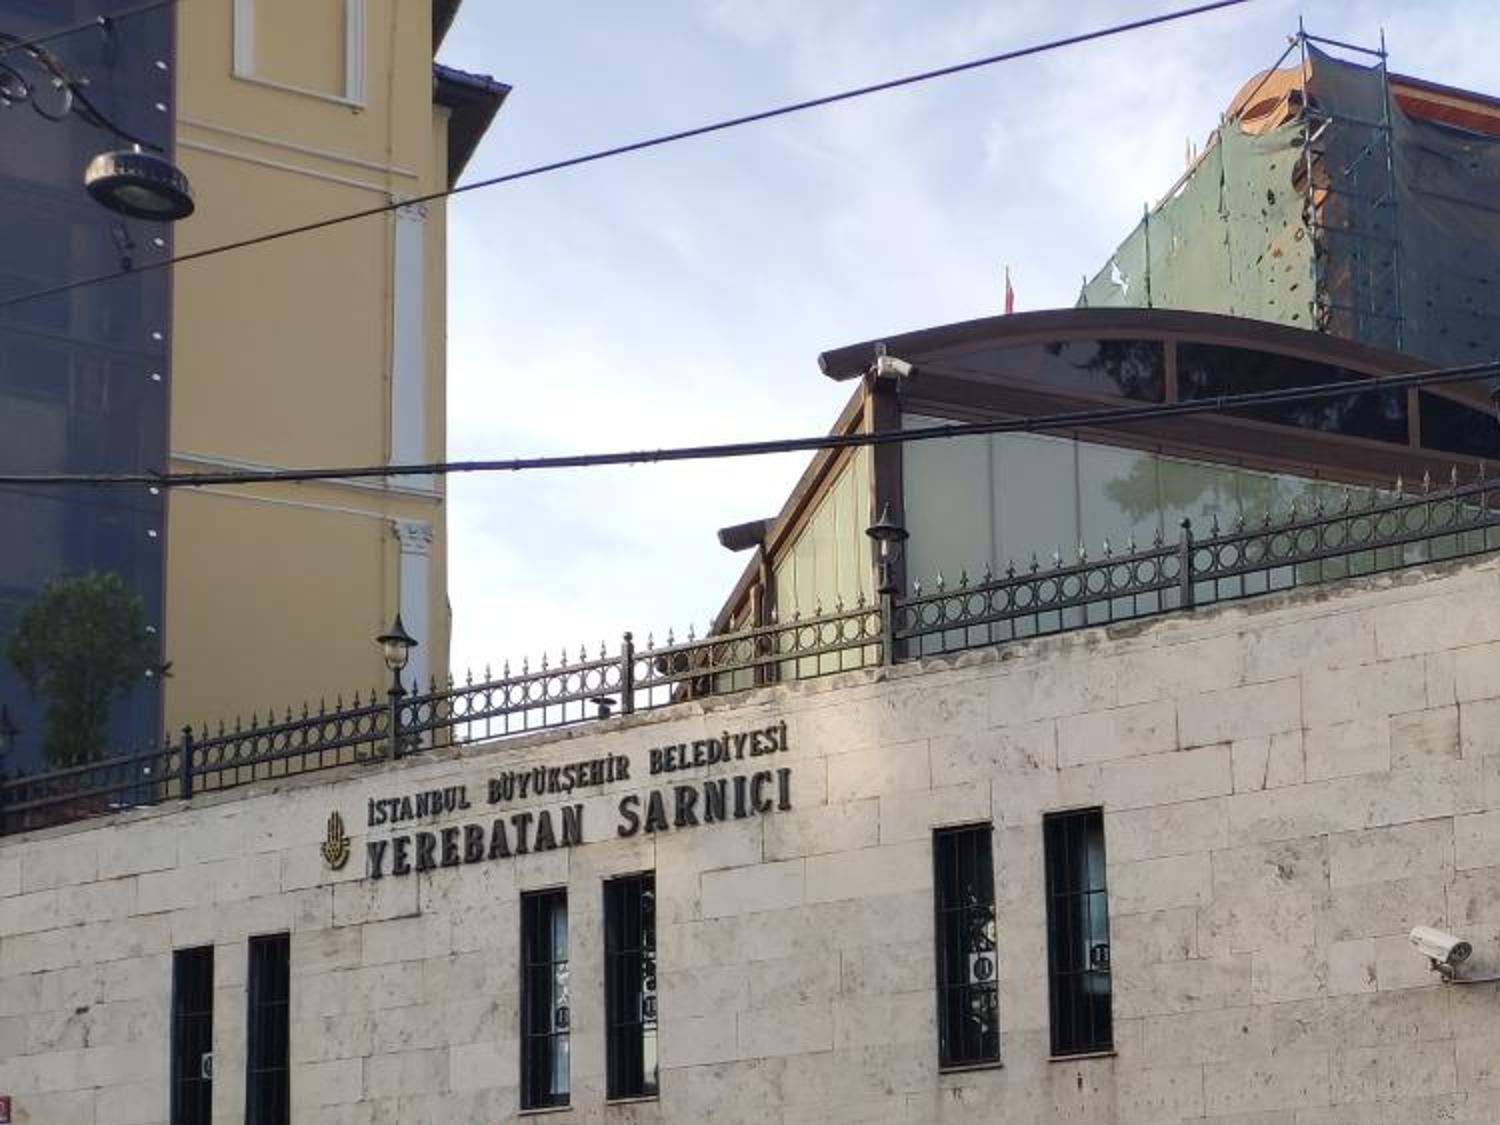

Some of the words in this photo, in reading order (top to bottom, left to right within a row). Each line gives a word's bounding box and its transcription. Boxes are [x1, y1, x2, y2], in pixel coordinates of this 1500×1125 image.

[366, 803, 585, 880] YEREBATAN
[617, 767, 792, 838] SARNICI
[367, 785, 471, 827] İSTANBUL
[487, 752, 630, 805] BÜYÜKŞEHİR
[648, 719, 789, 775] BELEDİYESİ
